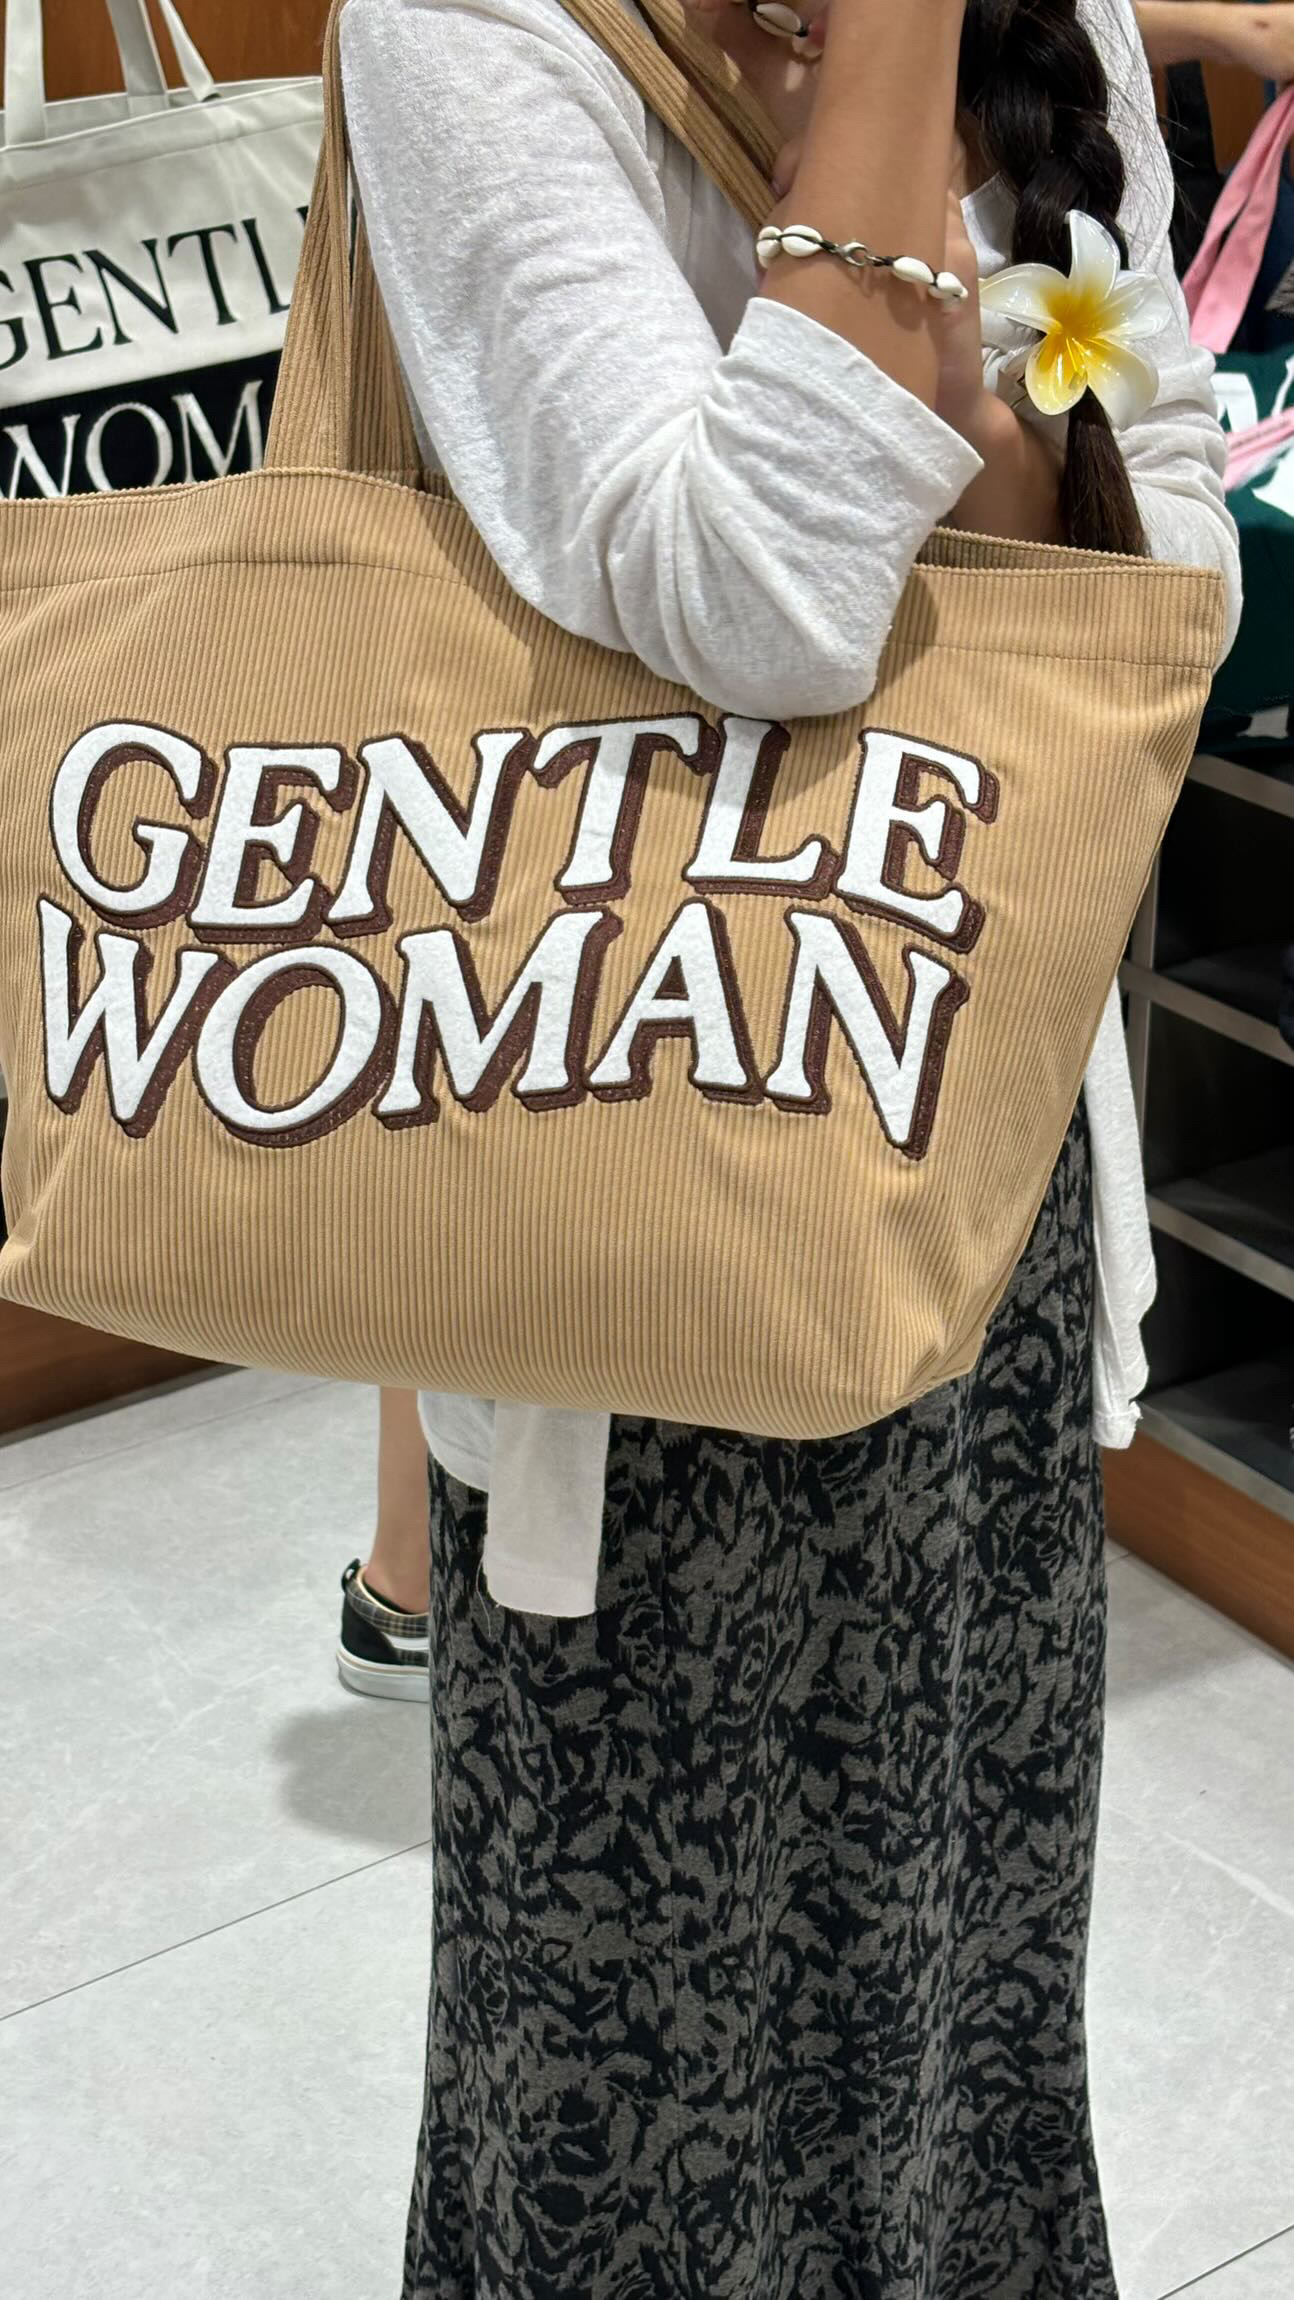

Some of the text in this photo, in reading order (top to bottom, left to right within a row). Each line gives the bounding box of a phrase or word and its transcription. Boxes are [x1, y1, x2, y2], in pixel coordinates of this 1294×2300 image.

[0, 205, 308, 371] ENTL
[0, 380, 264, 498] WOM
[50, 713, 998, 952] GENTLE
[38, 893, 970, 1159] WOMAN
